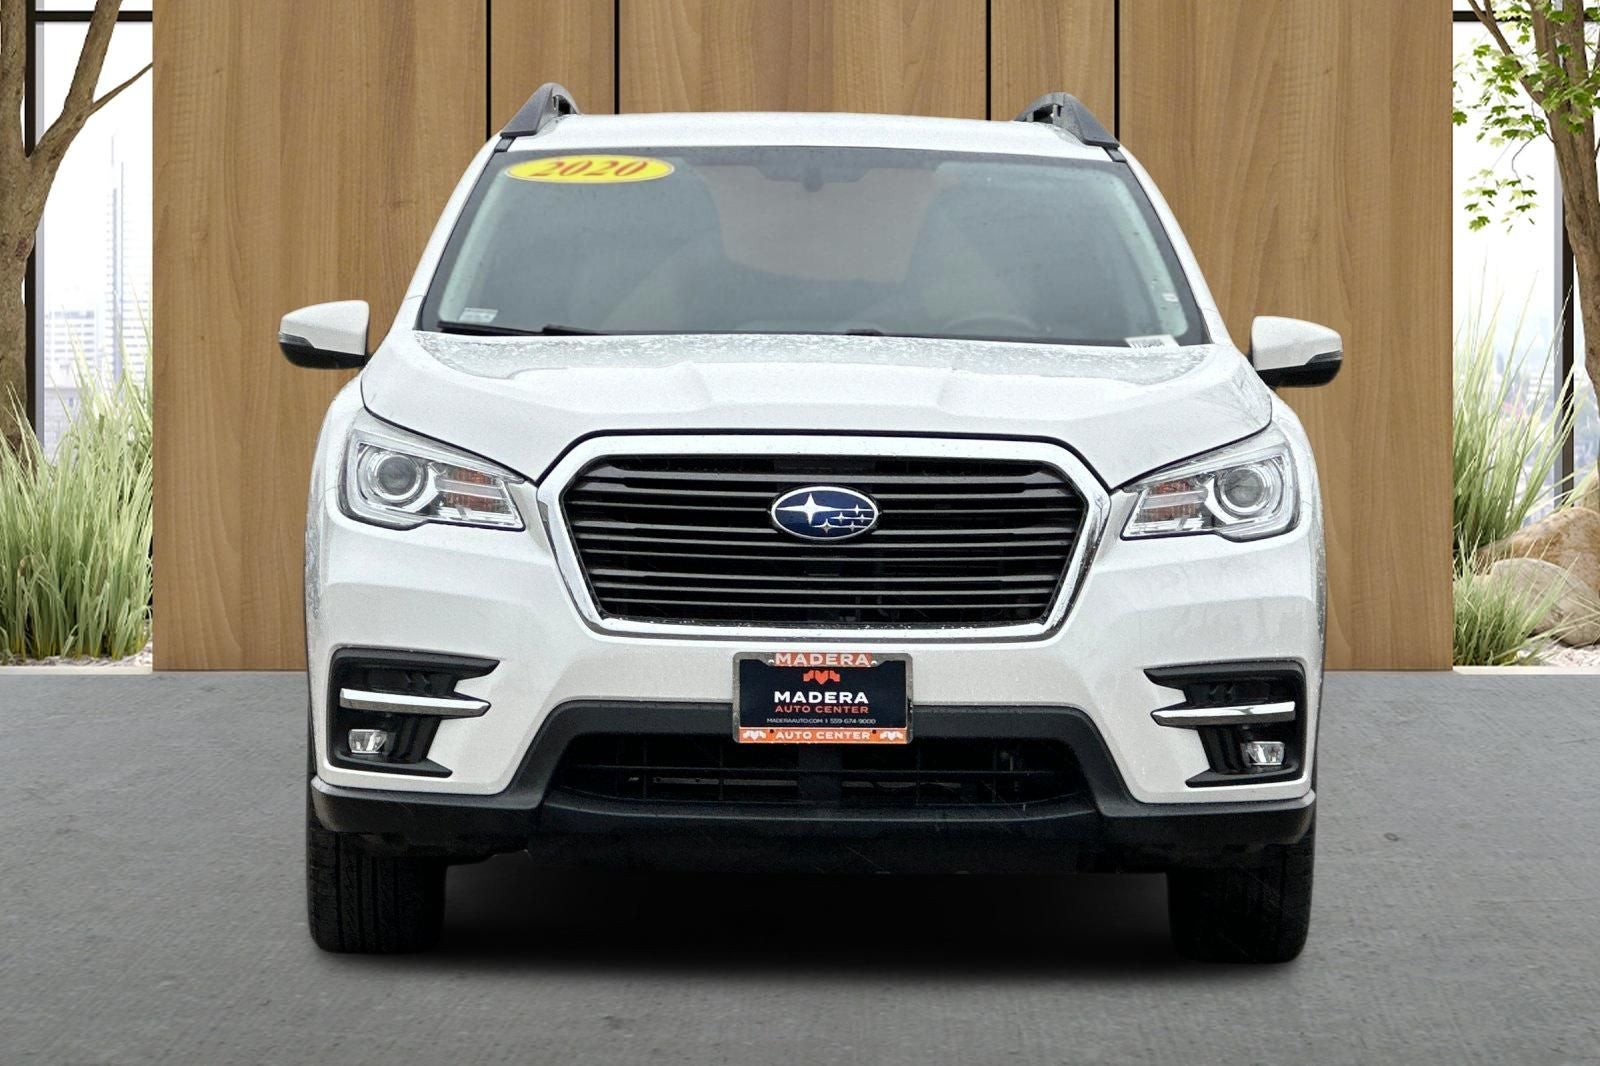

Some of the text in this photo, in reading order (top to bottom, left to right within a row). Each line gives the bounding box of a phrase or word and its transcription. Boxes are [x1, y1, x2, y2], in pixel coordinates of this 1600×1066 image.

[529, 160, 649, 176] 2020
[775, 653, 869, 666] MADERA
[774, 691, 869, 703] MADERA
[776, 731, 870, 740] AUTO CENTER
